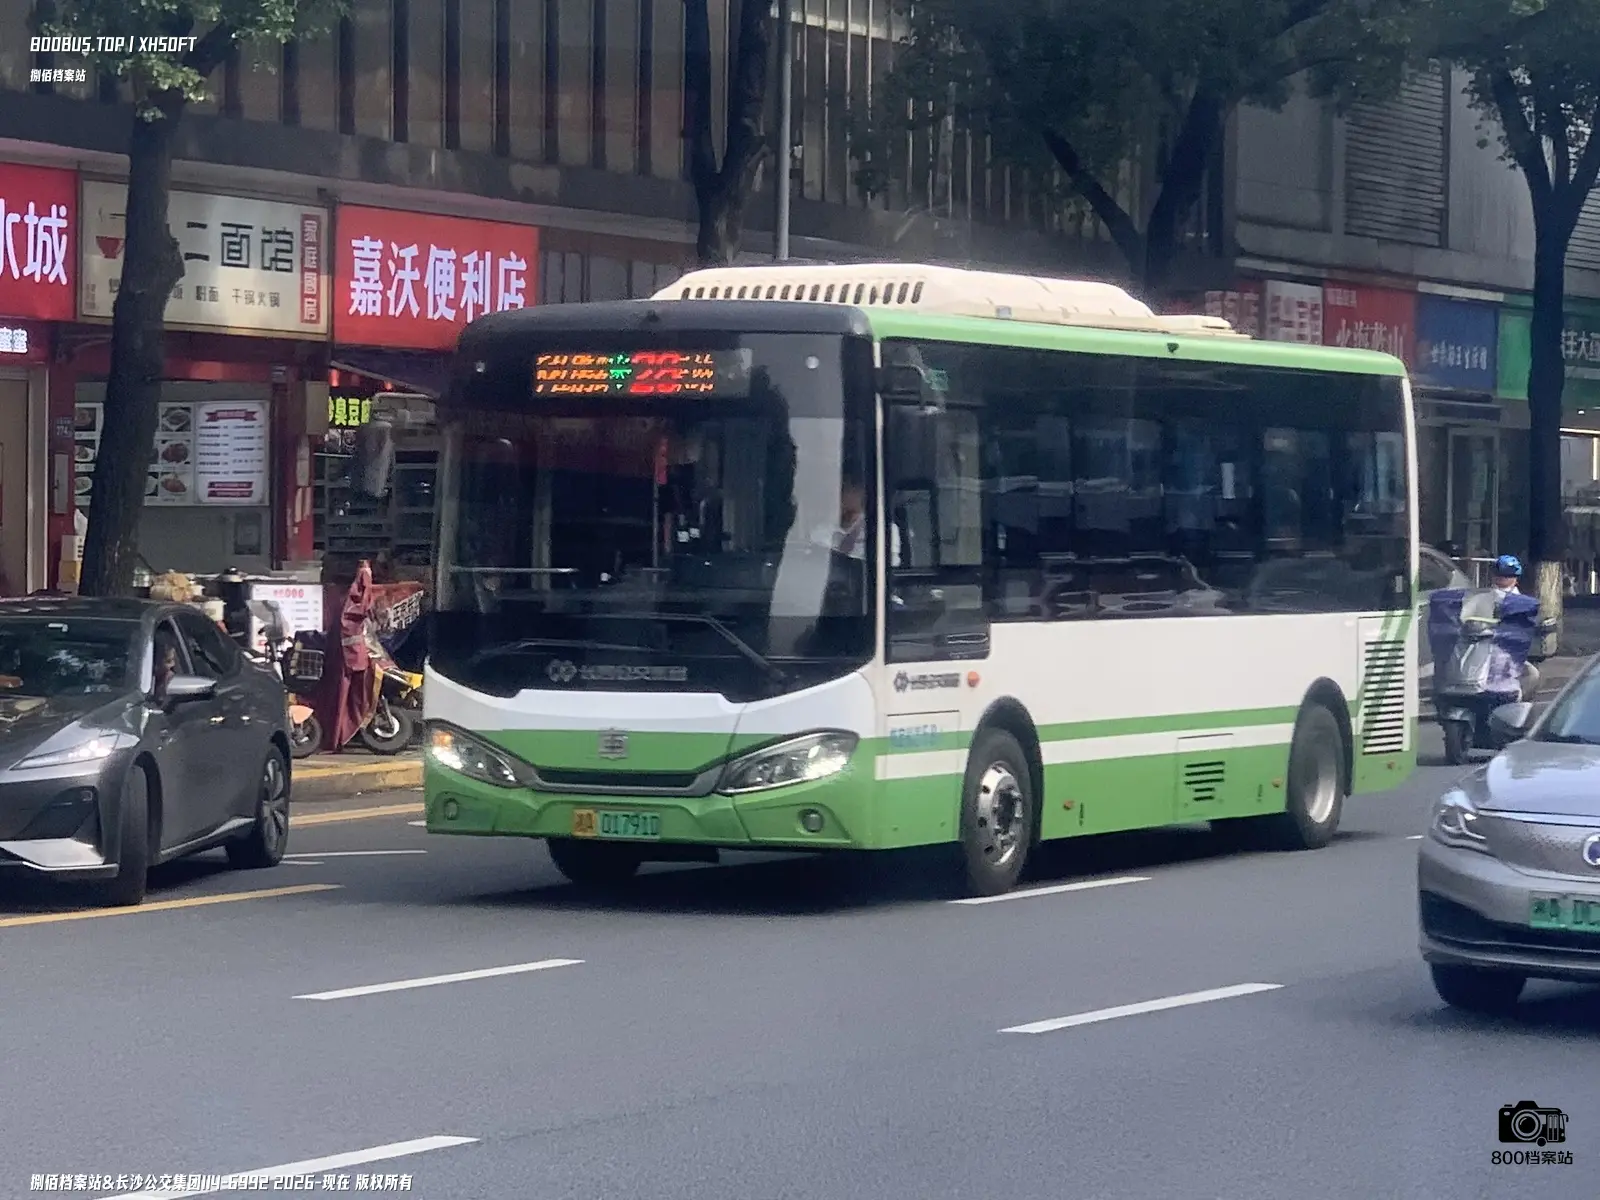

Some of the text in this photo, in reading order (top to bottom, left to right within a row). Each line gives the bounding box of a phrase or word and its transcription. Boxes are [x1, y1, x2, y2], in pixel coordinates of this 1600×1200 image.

[348, 235, 527, 324] 嘉沃便利店
